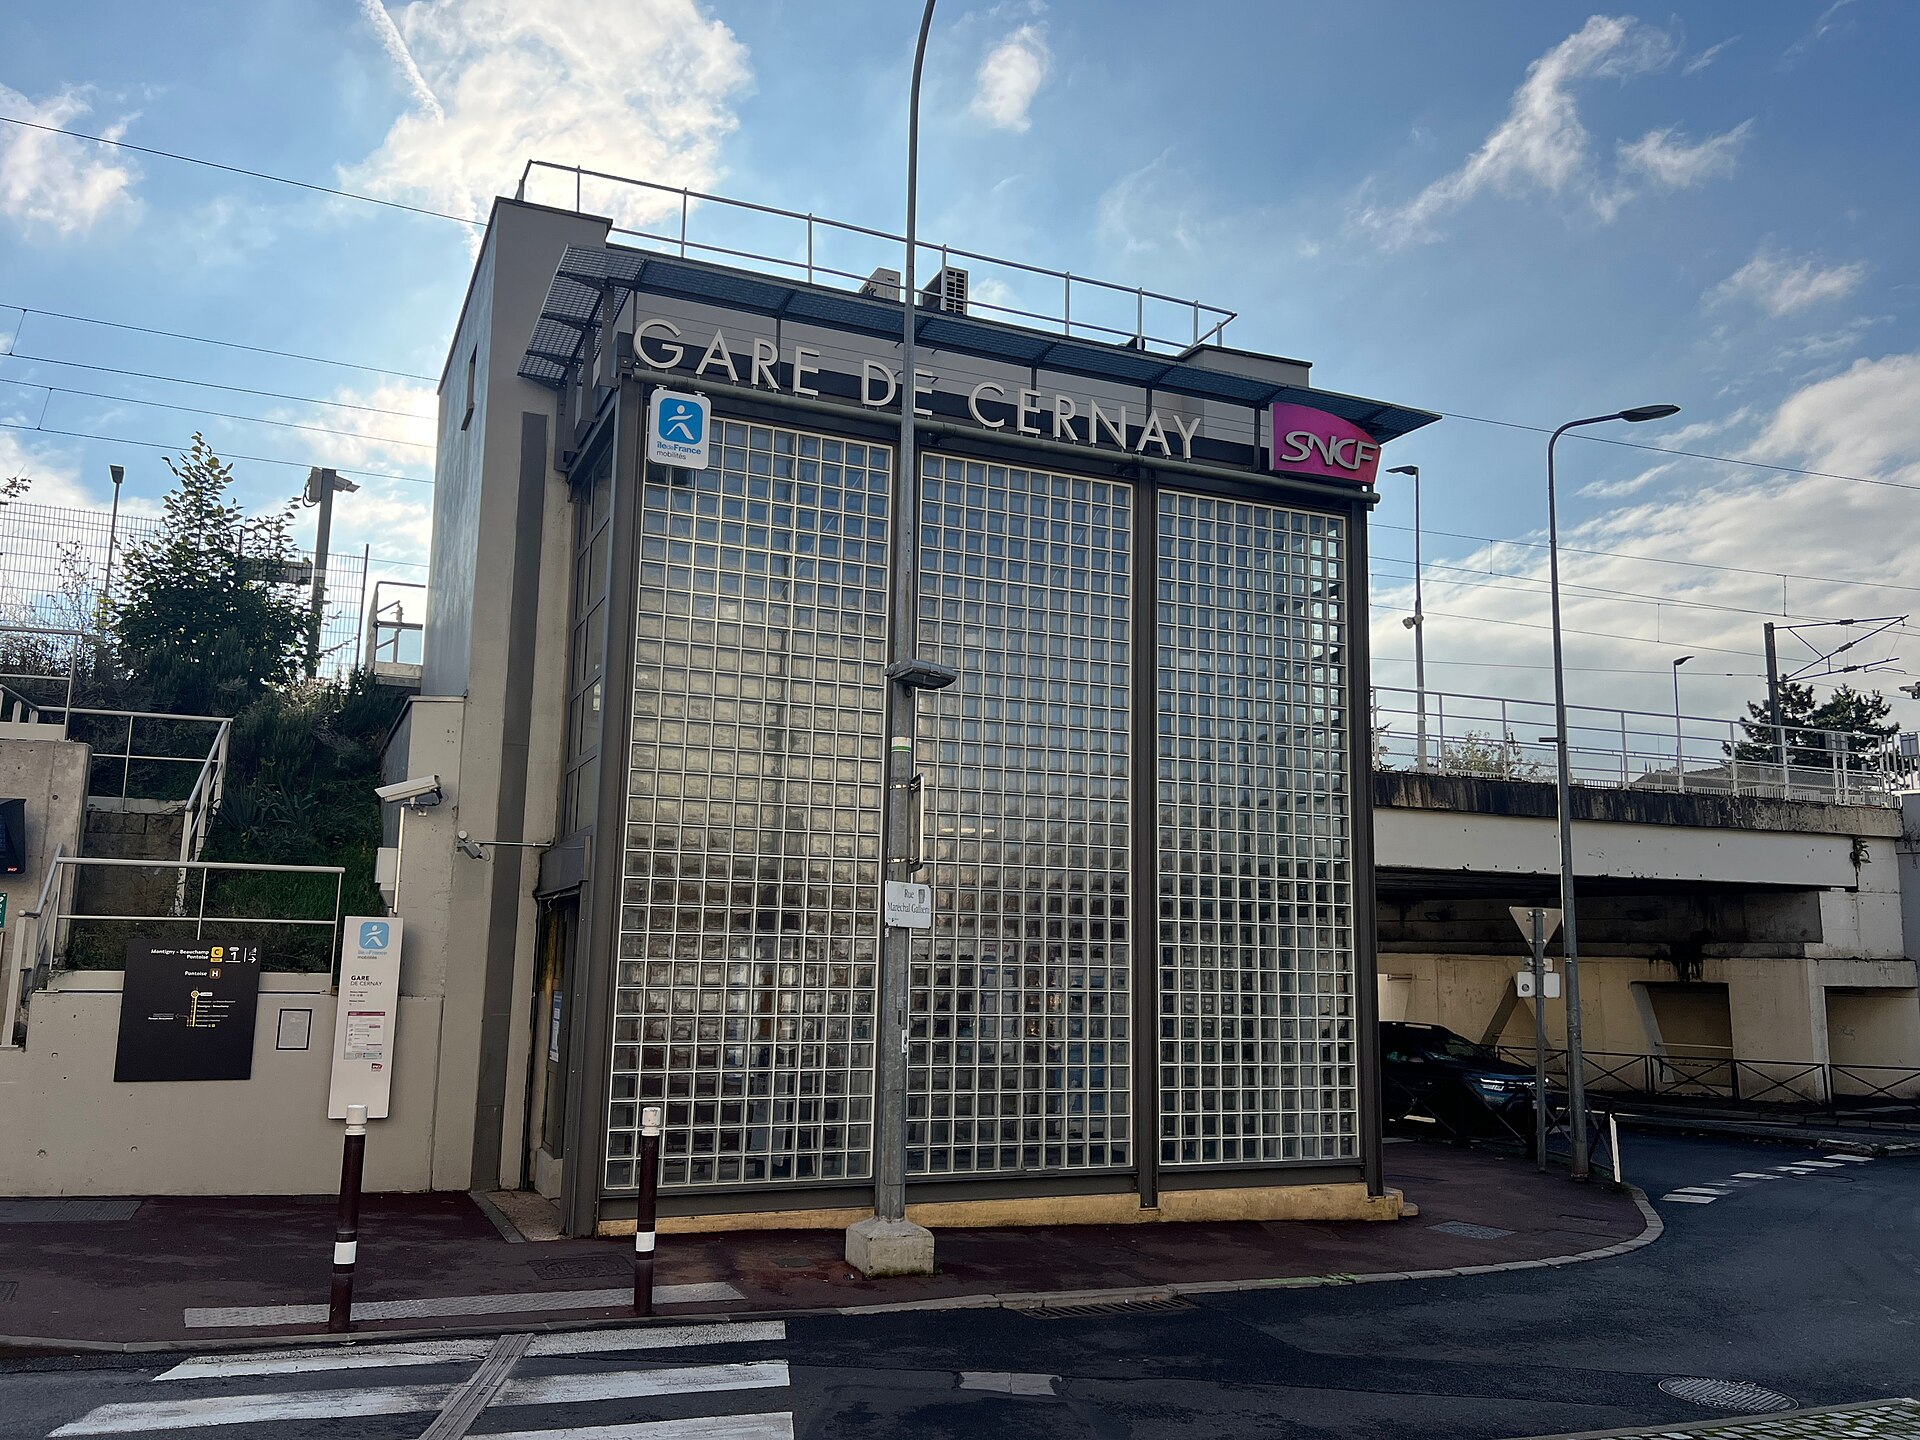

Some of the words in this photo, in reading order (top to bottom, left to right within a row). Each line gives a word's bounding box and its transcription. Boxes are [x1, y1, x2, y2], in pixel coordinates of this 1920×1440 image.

[632, 318, 820, 396] GARE
[861, 359, 934, 416] DE
[968, 381, 1201, 460] CERNAY
[656, 450, 687, 460] mobilités
[1280, 431, 1380, 471] SNCF
[904, 889, 914, 898] Rue
[231, 952, 236, 960] 1
